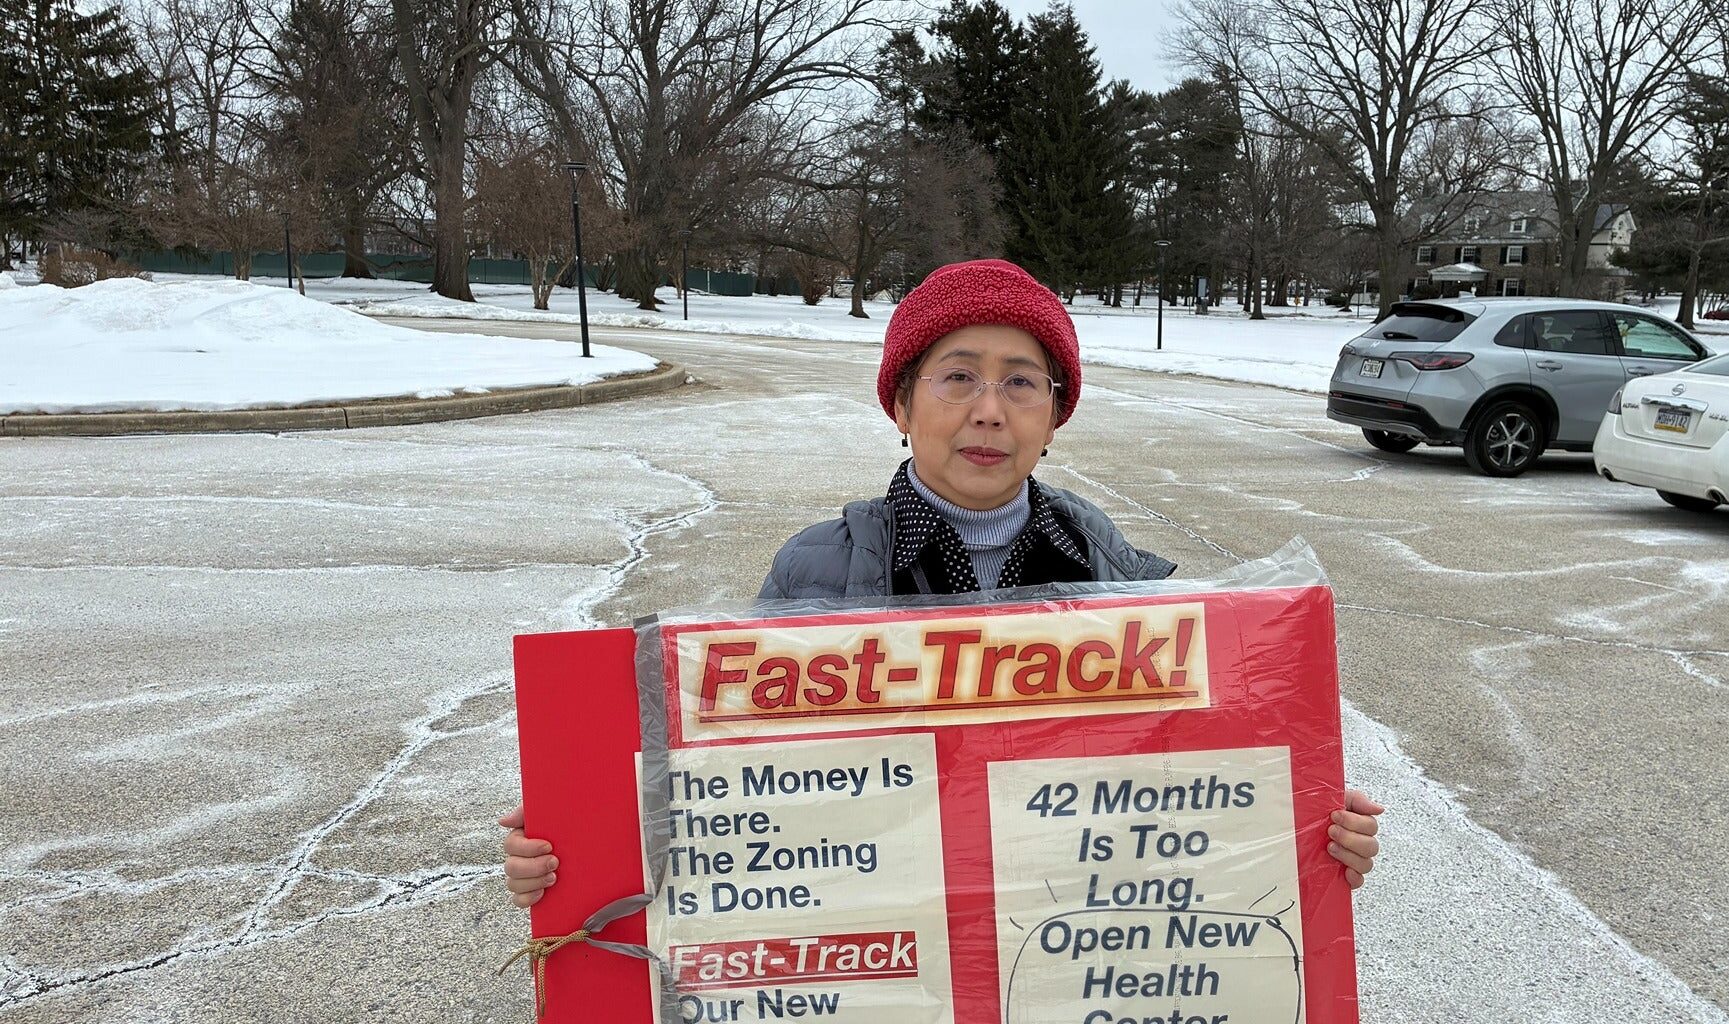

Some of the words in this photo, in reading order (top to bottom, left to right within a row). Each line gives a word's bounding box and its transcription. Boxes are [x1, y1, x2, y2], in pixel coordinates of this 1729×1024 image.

[699, 618, 1196, 712] Fast-Track!
[742, 764, 869, 797] Money
[882, 757, 914, 788] Is
[1026, 782, 1079, 818] 42
[1091, 775, 1256, 815] Months
[669, 846, 734, 877] The
[746, 838, 878, 873] Zoning
[1078, 828, 1114, 862] Is
[1129, 824, 1210, 860] Too
[667, 885, 699, 916] Is
[712, 882, 821, 914] Done.
[1086, 874, 1204, 912] Long.
[671, 932, 917, 982] Fast-Track
[1040, 920, 1150, 960] Open
[1165, 915, 1261, 949] New
[1082, 963, 1220, 999] Health
[757, 988, 840, 1020] New
